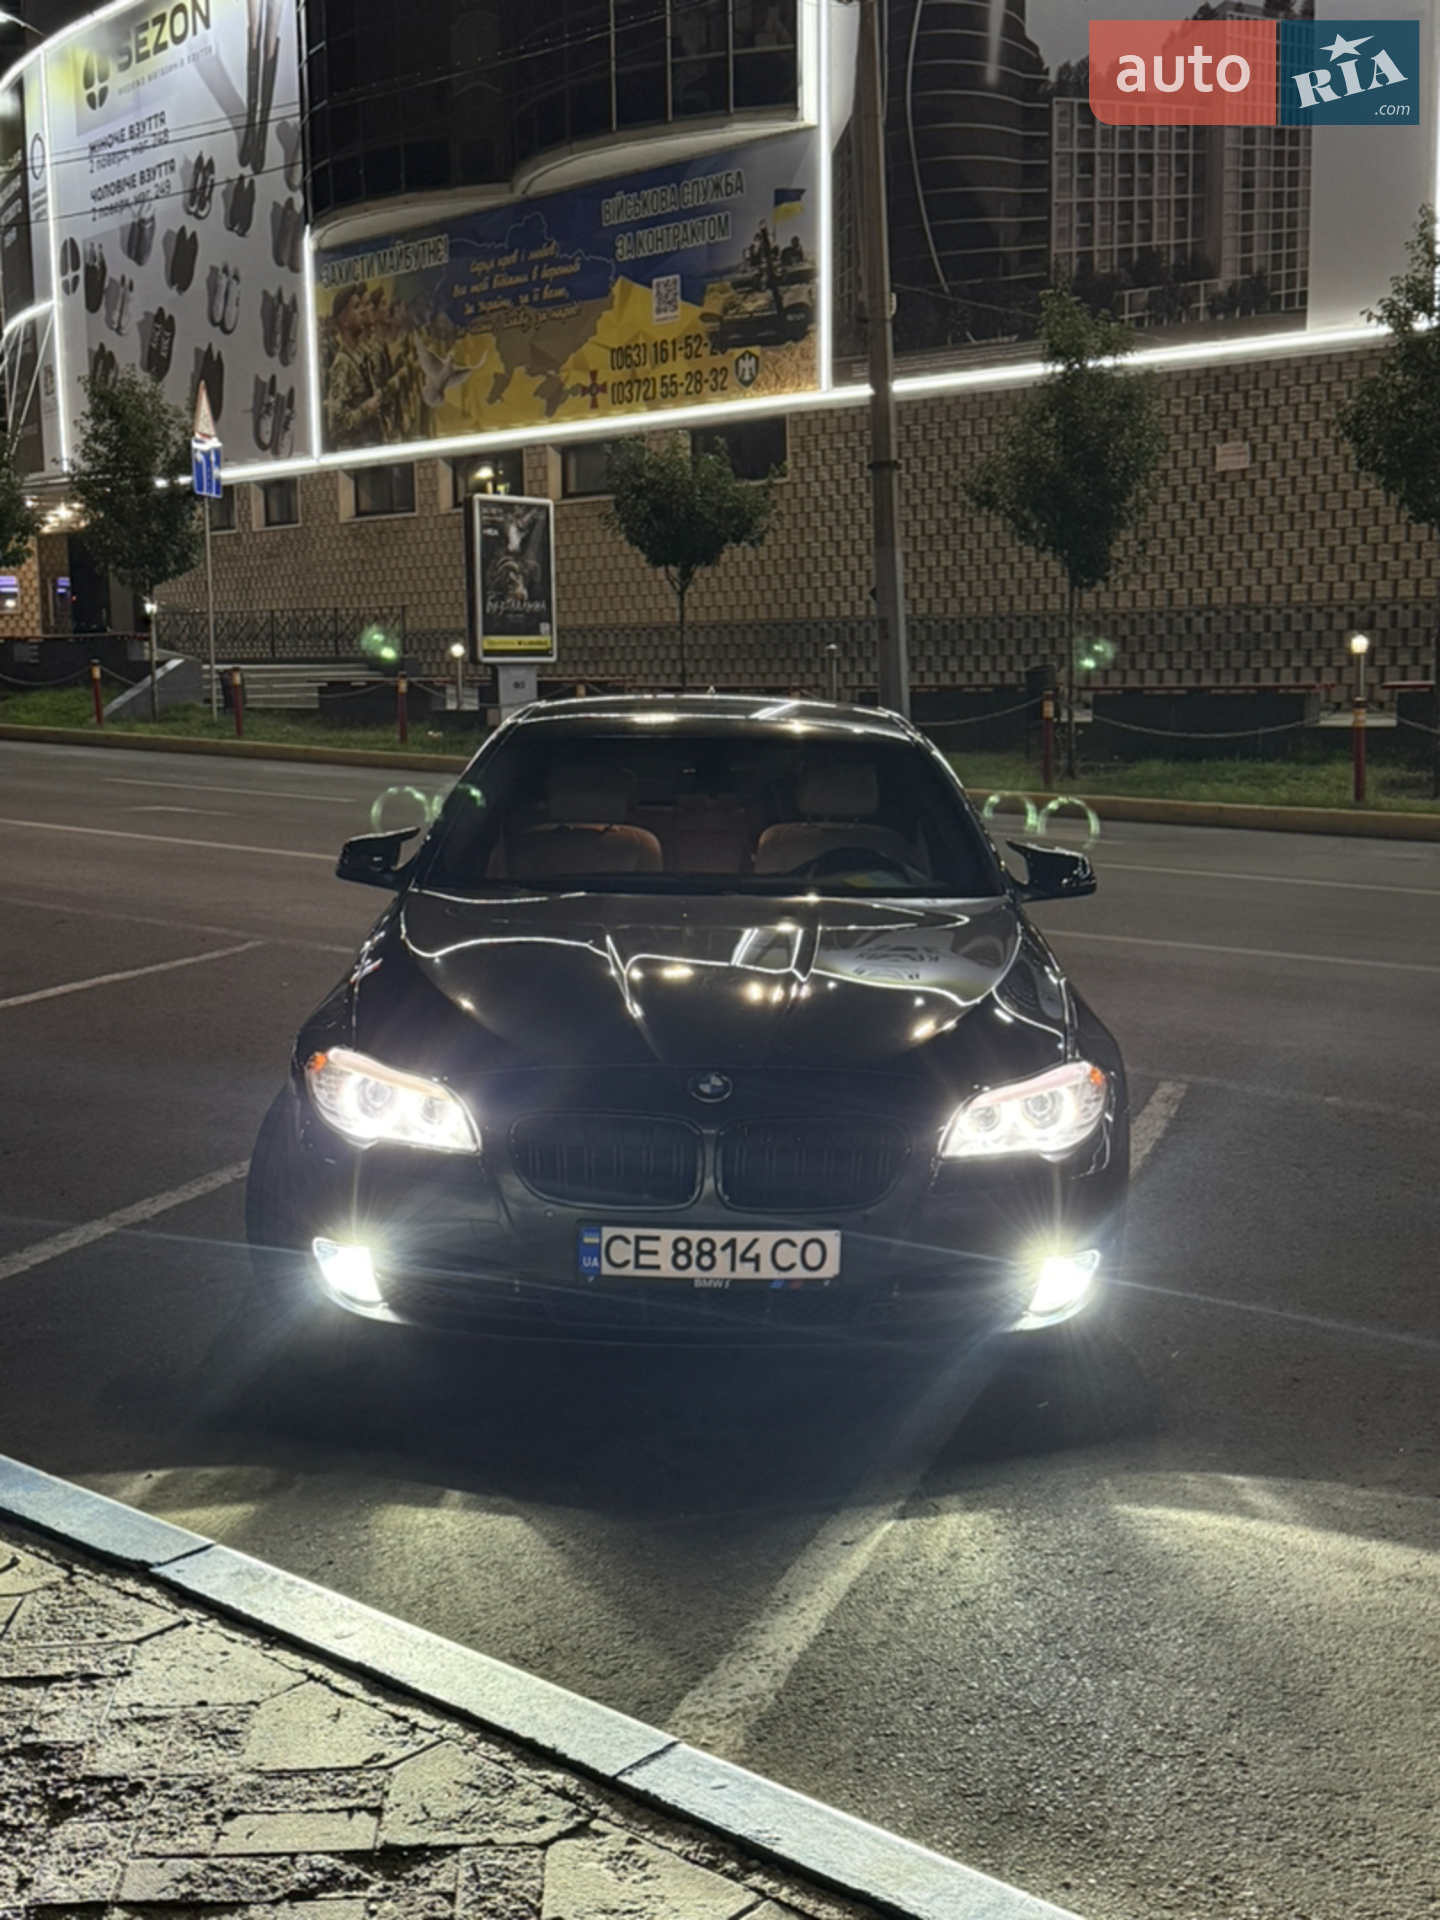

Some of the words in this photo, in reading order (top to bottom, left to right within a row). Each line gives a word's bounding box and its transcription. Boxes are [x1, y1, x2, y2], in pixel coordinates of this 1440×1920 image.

[117, 0, 211, 73] SEZON
[128, 110, 166, 140] ВЗУТТЯ
[139, 158, 176, 185] ВЗУТТЯ
[602, 183, 679, 227] ВІЙСЬКОВА
[680, 169, 746, 209] СЛУЖБА
[615, 232, 635, 262] ЗА
[636, 212, 732, 257] КОНТРАКТОМ
[321, 252, 376, 292] ЗАХИСТИ
[376, 234, 450, 277] МАЙБУТНЄ!
[610, 343, 648, 371] (063)
[611, 377, 656, 405] (0372)
[660, 366, 729, 399] 55-28-32
[582, 1256, 600, 1268] UA
[604, 1234, 661, 1270] CE
[671, 1236, 761, 1272] 8814
[770, 1237, 828, 1272] CO
